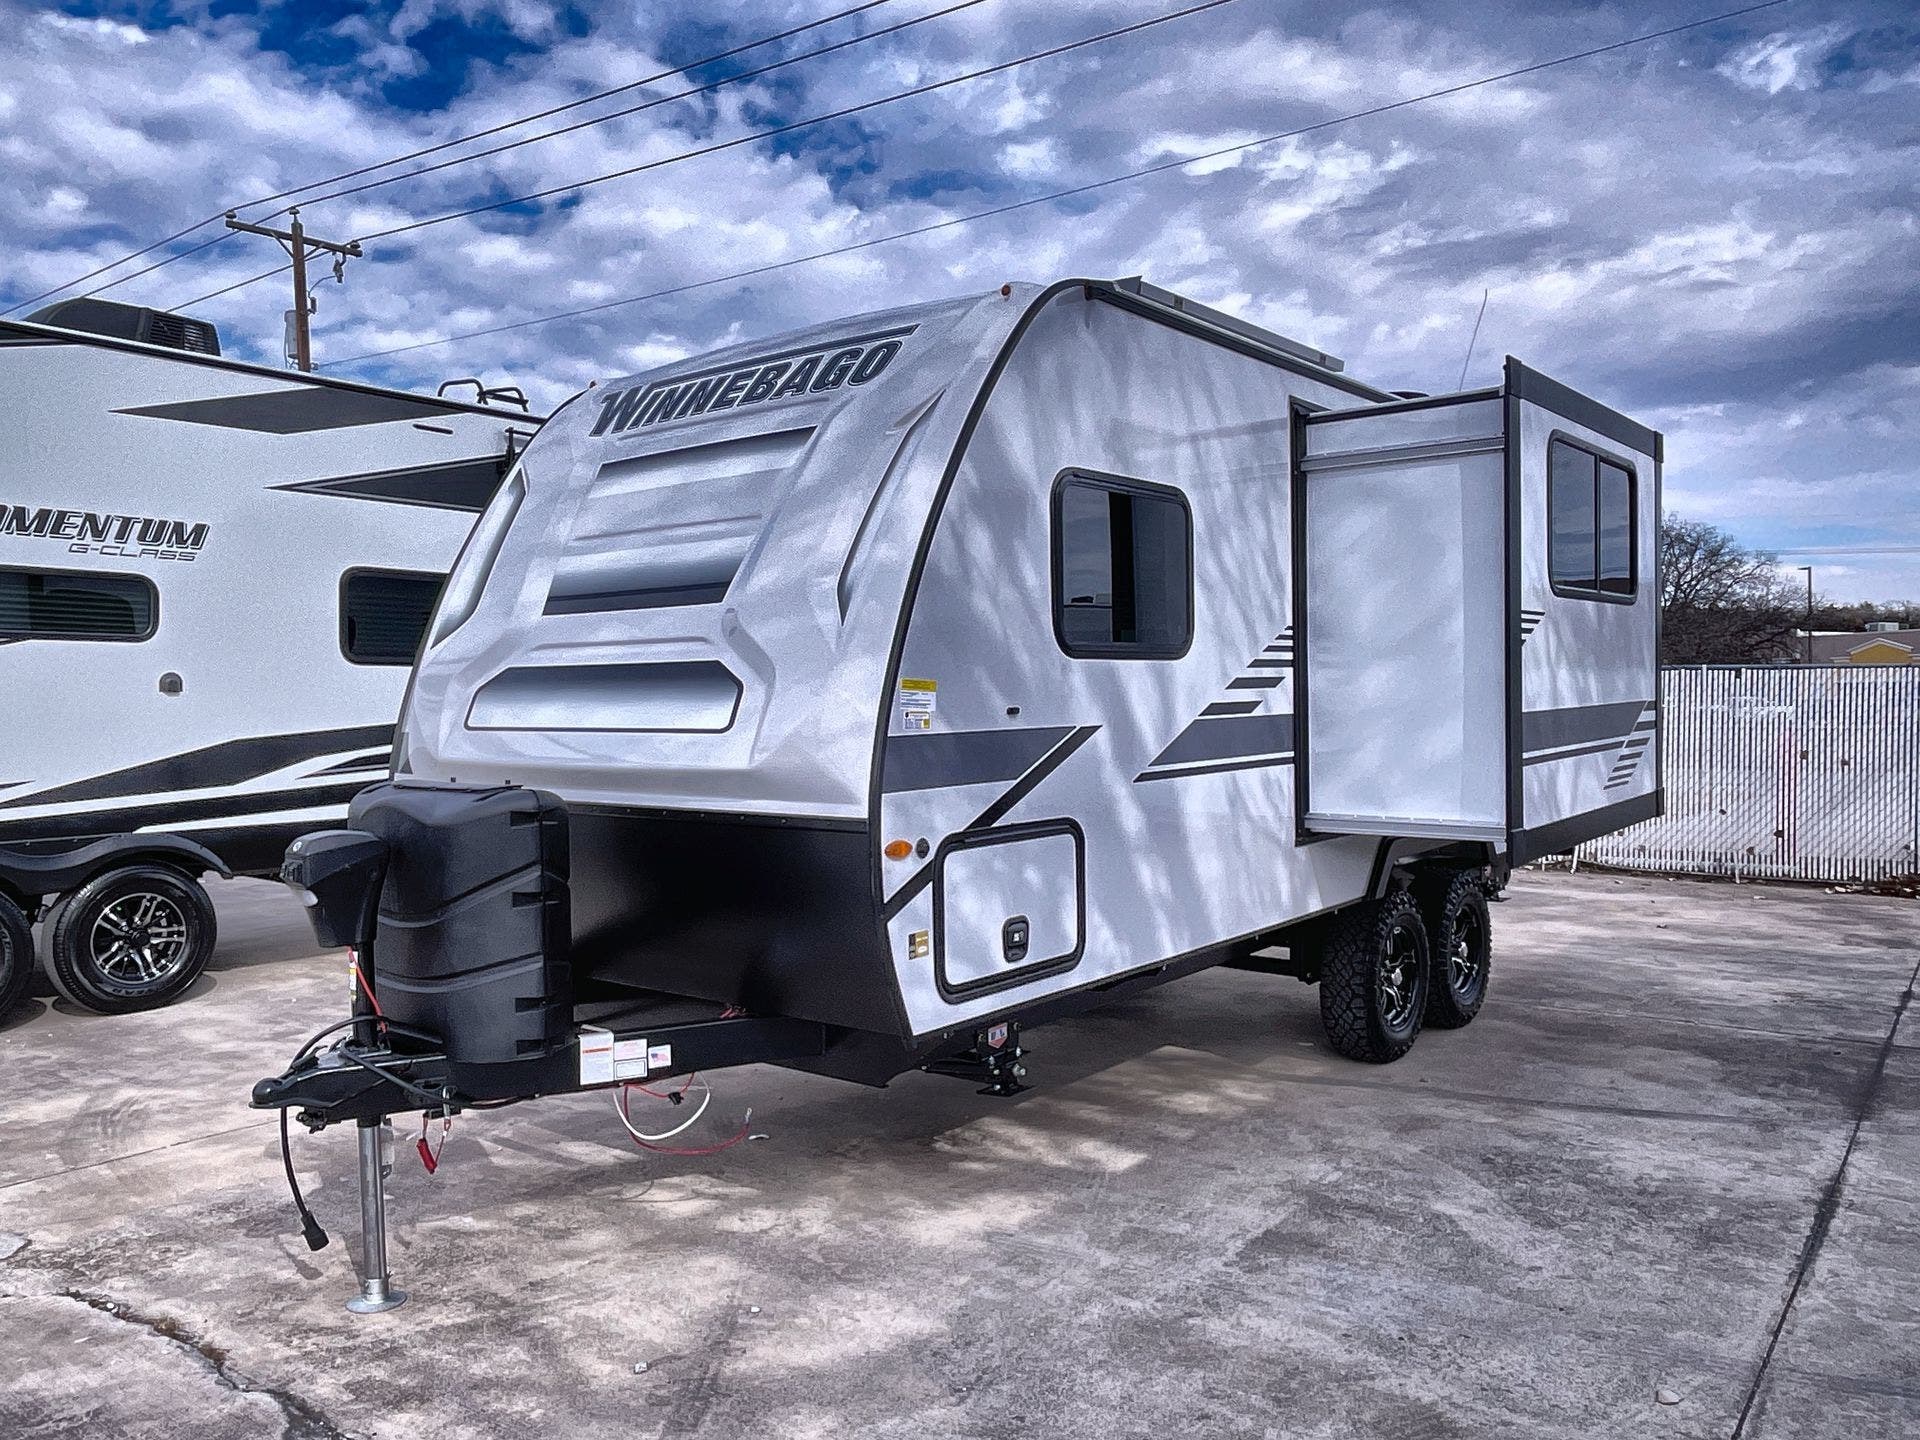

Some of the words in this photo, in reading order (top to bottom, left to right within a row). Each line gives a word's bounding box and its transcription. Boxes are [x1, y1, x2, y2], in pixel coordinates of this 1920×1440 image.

[588, 340, 903, 437] WINNEBAGO
[0, 503, 210, 550] MENTUM
[68, 542, 198, 562] G-CLASS
